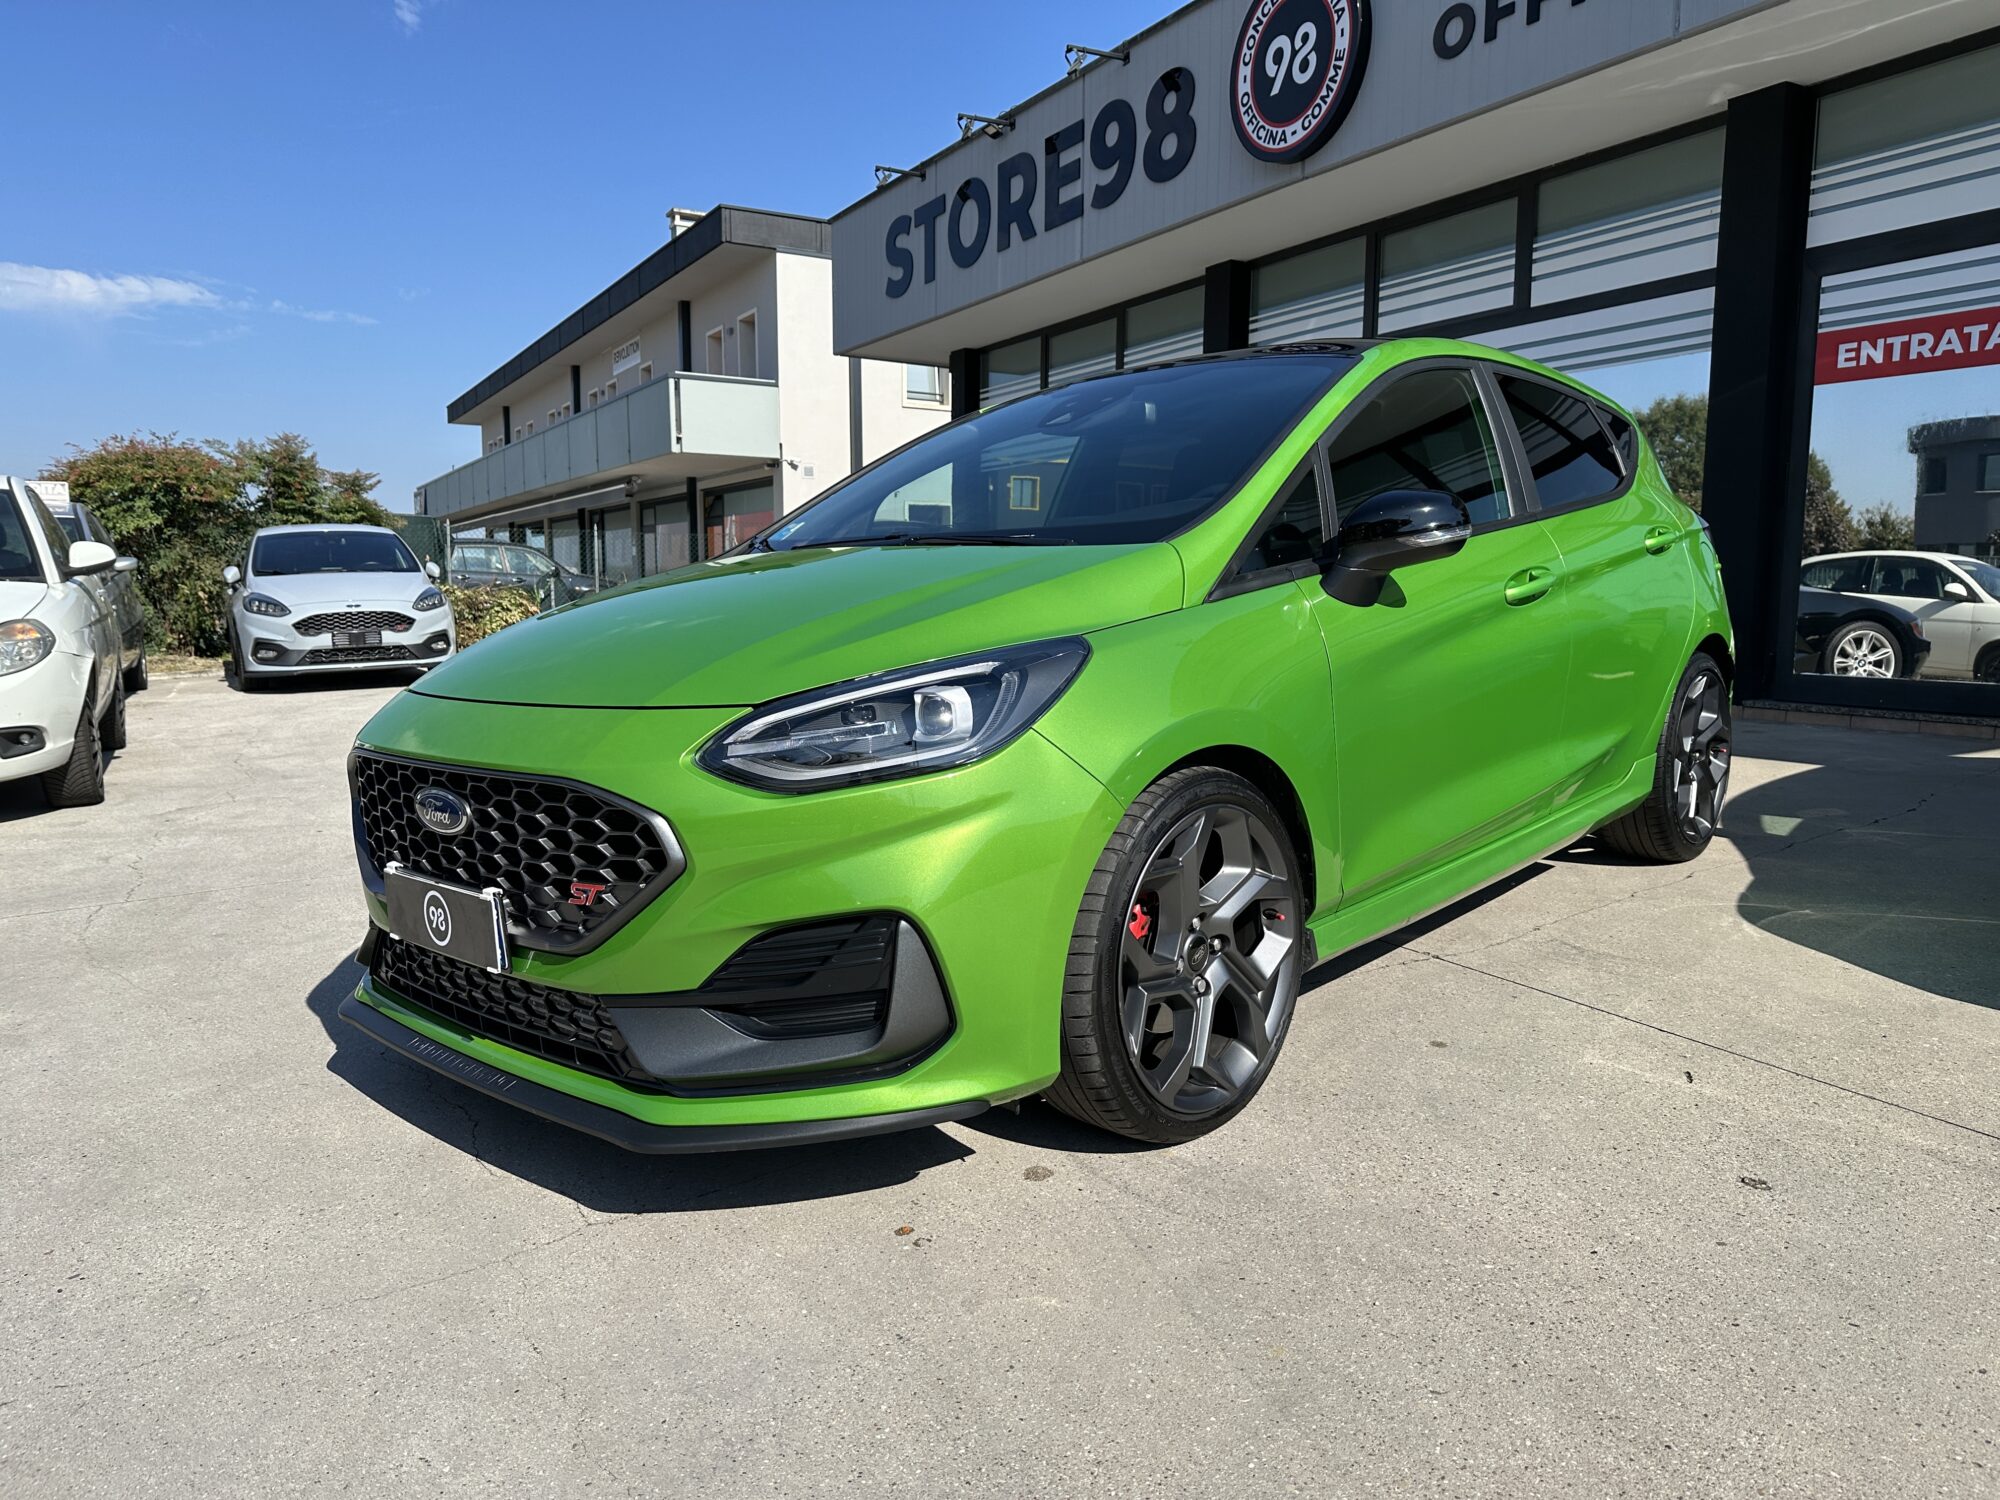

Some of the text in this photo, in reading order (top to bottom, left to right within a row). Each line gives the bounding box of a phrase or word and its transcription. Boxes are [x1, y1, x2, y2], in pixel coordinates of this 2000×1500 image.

[1433, 0, 1586, 60] OF
[1265, 21, 1317, 97] 98
[1301, 47, 1346, 131] GOMME
[1240, 91, 1288, 146] OFFICINA
[885, 66, 1197, 299] STORE98
[424, 798, 451, 825] Ford
[429, 905, 446, 931] 98
[568, 882, 606, 906] ST
